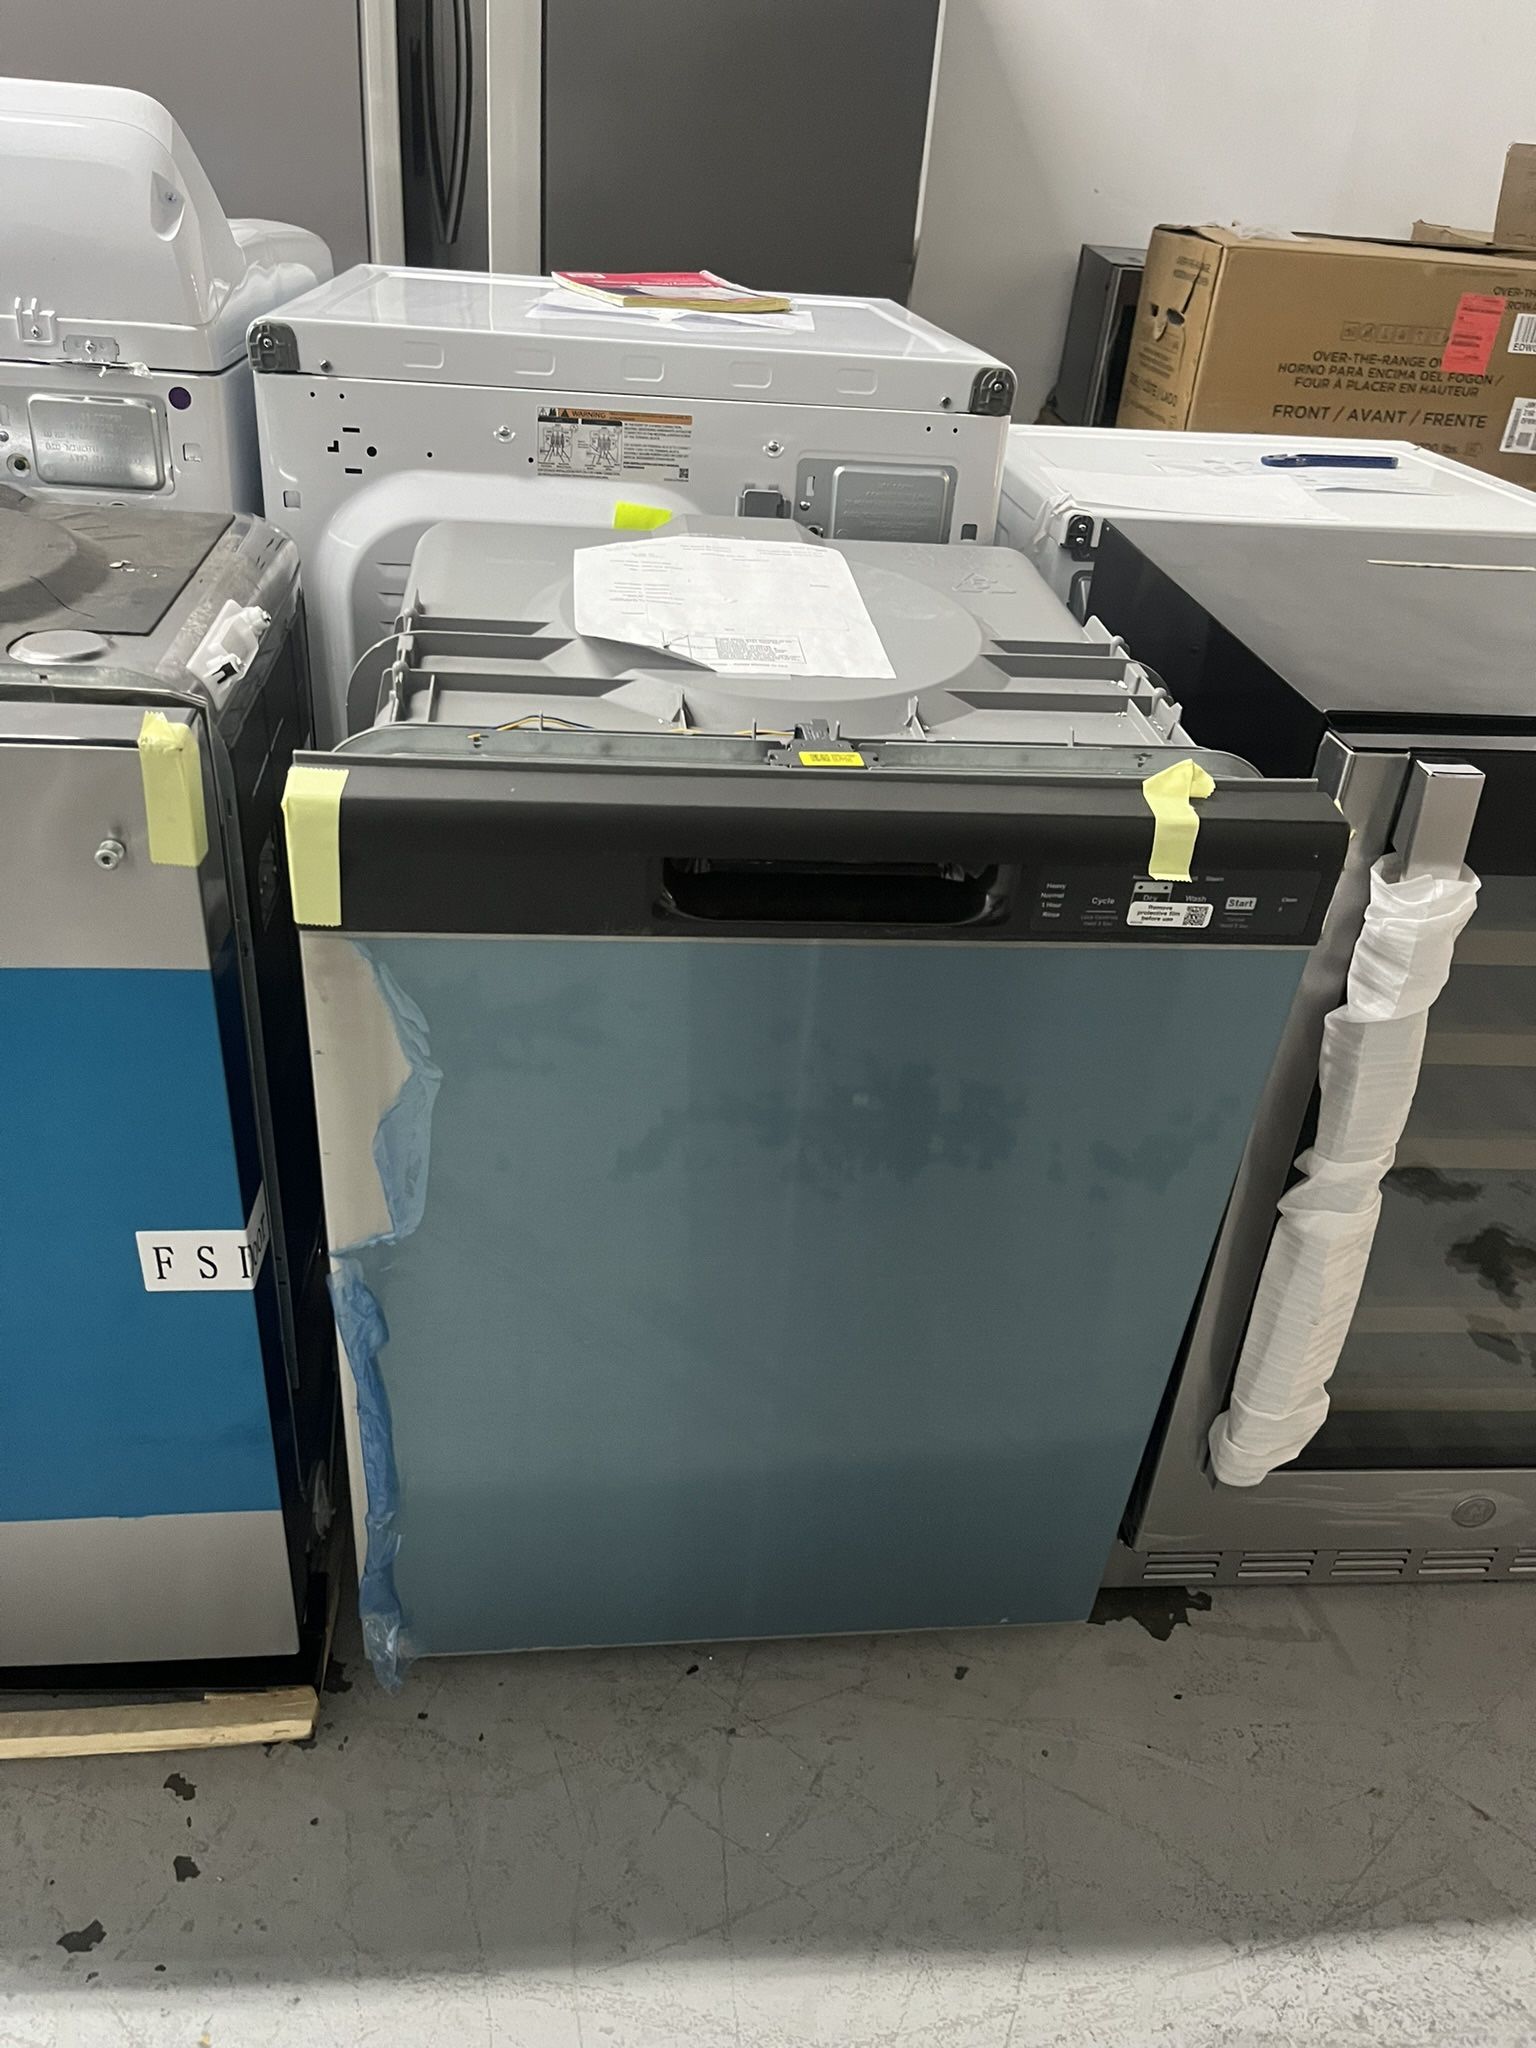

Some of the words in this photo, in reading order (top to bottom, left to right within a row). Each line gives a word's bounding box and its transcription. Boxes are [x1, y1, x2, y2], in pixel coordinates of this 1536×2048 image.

[1313, 350, 1426, 368] OVER-THE-RANGE
[1278, 362, 1325, 376] HORNO
[1329, 365, 1364, 378] PARA
[1368, 367, 1416, 382] ENCIMA
[1420, 370, 1444, 382] DEL
[1294, 377, 1329, 390] FOUR
[1345, 379, 1396, 393] PLACER
[1399, 382, 1417, 393] EN
[1419, 383, 1480, 398] HAUTEUR
[572, 410, 606, 419] WARNING
[1272, 404, 1330, 420] FRONT
[1332, 407, 1346, 422] /
[1346, 408, 1407, 424] AVANT
[1408, 410, 1422, 426] /
[1422, 412, 1489, 429] FRENTE
[1091, 896, 1116, 906] Cycle
[1185, 895, 1207, 903] Wash
[1228, 898, 1254, 908] Start
[1137, 910, 1167, 918] protective
[152, 1246, 174, 1280] F
[197, 1245, 218, 1280] S
